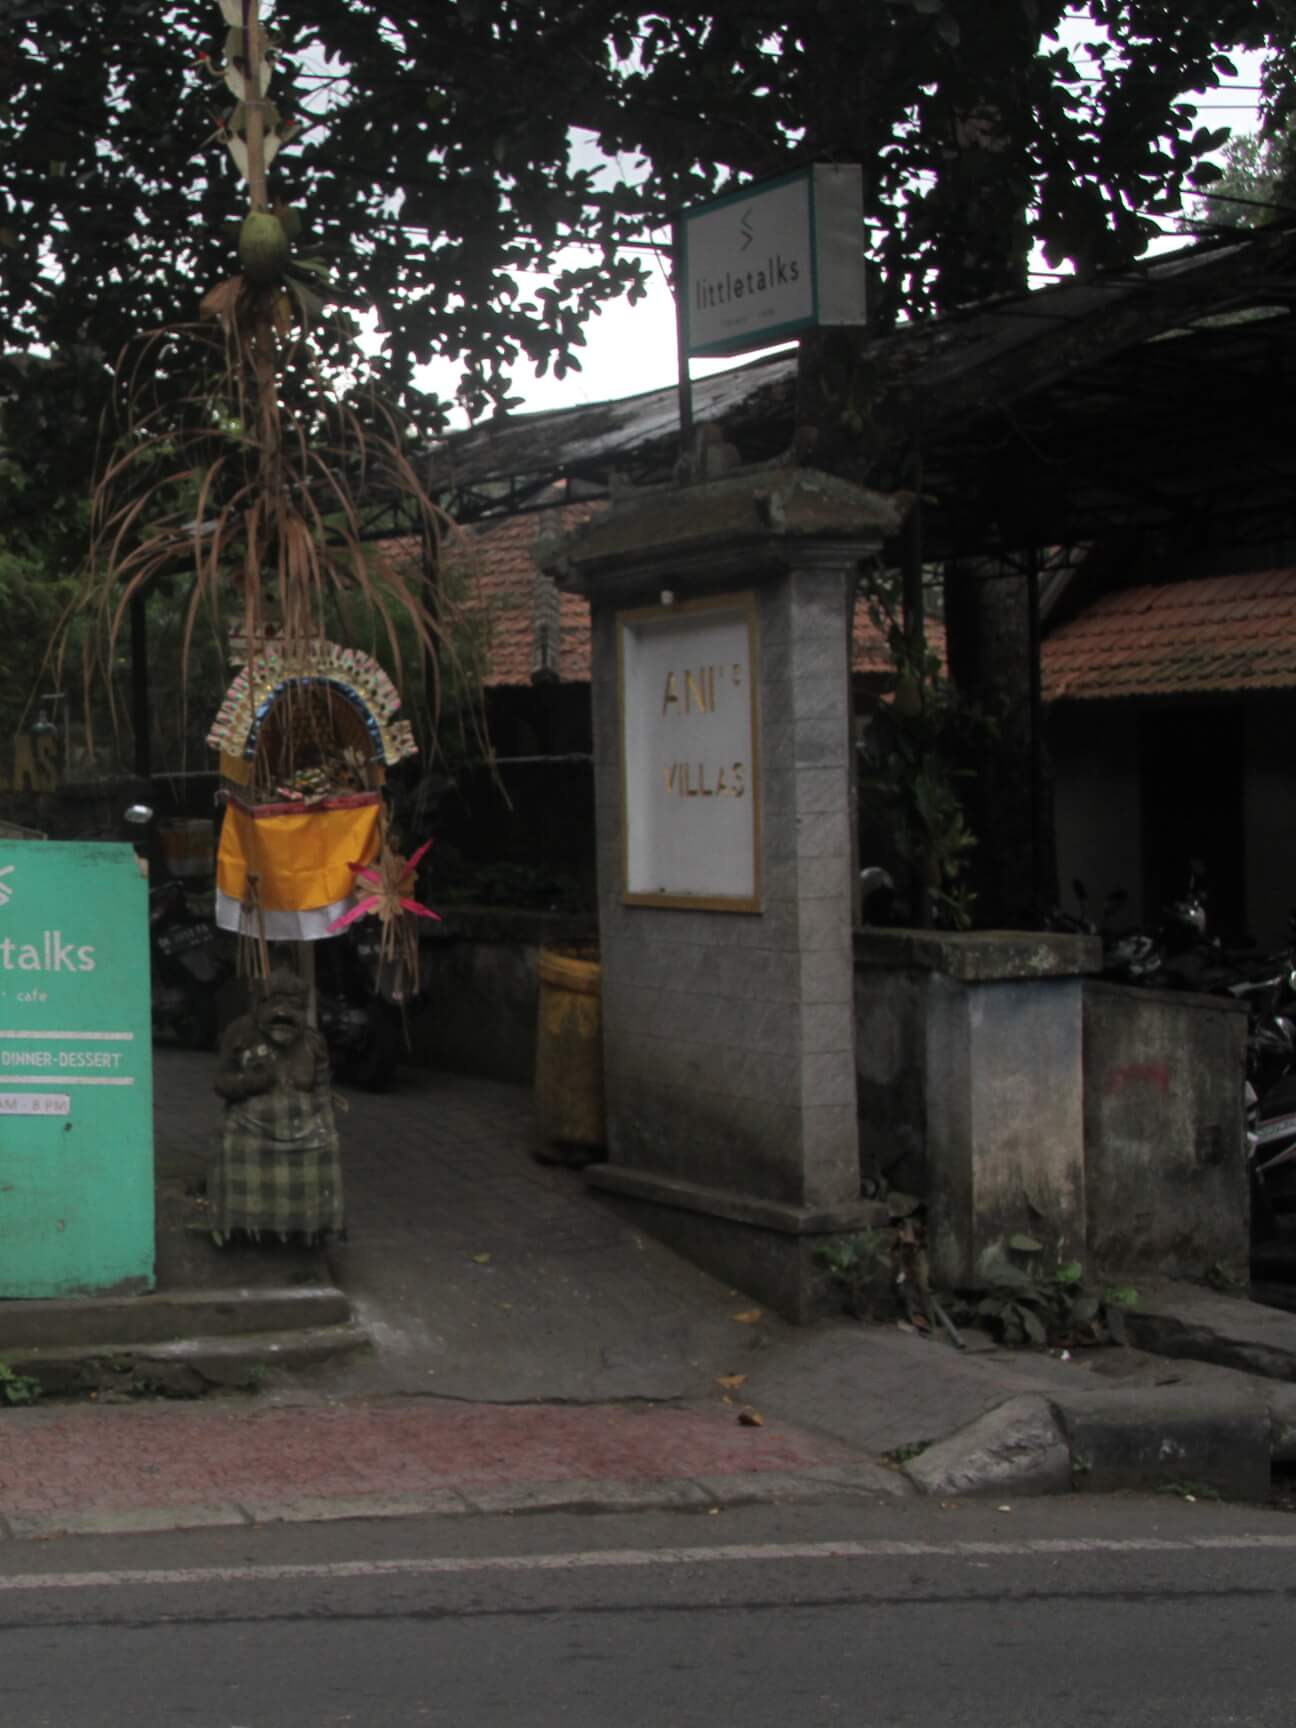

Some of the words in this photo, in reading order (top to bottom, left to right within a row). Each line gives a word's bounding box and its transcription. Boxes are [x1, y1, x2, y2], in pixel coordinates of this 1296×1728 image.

[696, 256, 800, 310] littletalks
[661, 760, 745, 799] VILLAS
[16, 987, 49, 1003] cafe
[45, 1099, 68, 1113] PM
